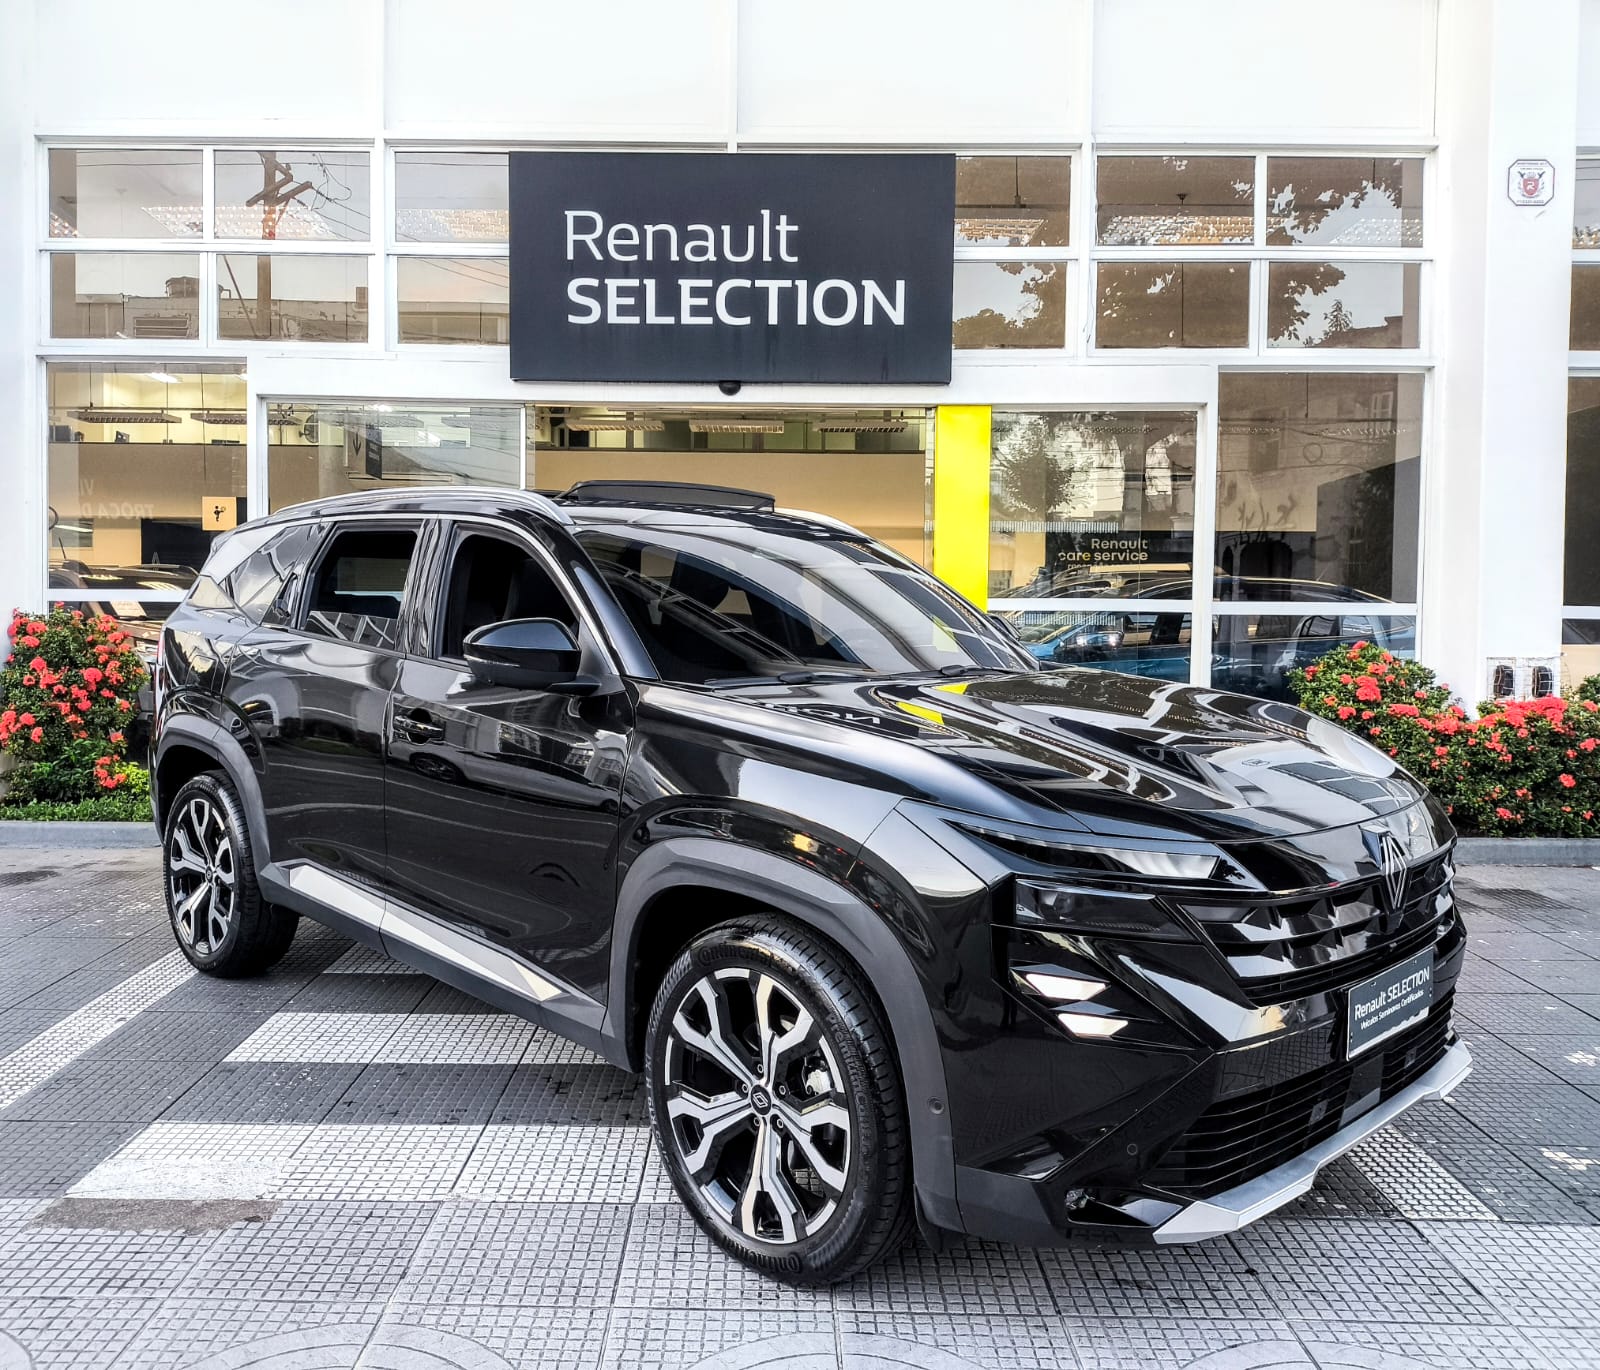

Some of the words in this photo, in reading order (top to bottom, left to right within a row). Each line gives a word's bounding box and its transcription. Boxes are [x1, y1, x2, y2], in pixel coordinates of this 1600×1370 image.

[564, 209, 799, 263] Renault
[567, 277, 905, 327] SELECTION
[1058, 551, 1091, 561] care
[1094, 549, 1148, 561] service
[1091, 538, 1148, 549] Renault
[1354, 991, 1386, 1021] Renault
[1387, 966, 1430, 1003] SELECTION
